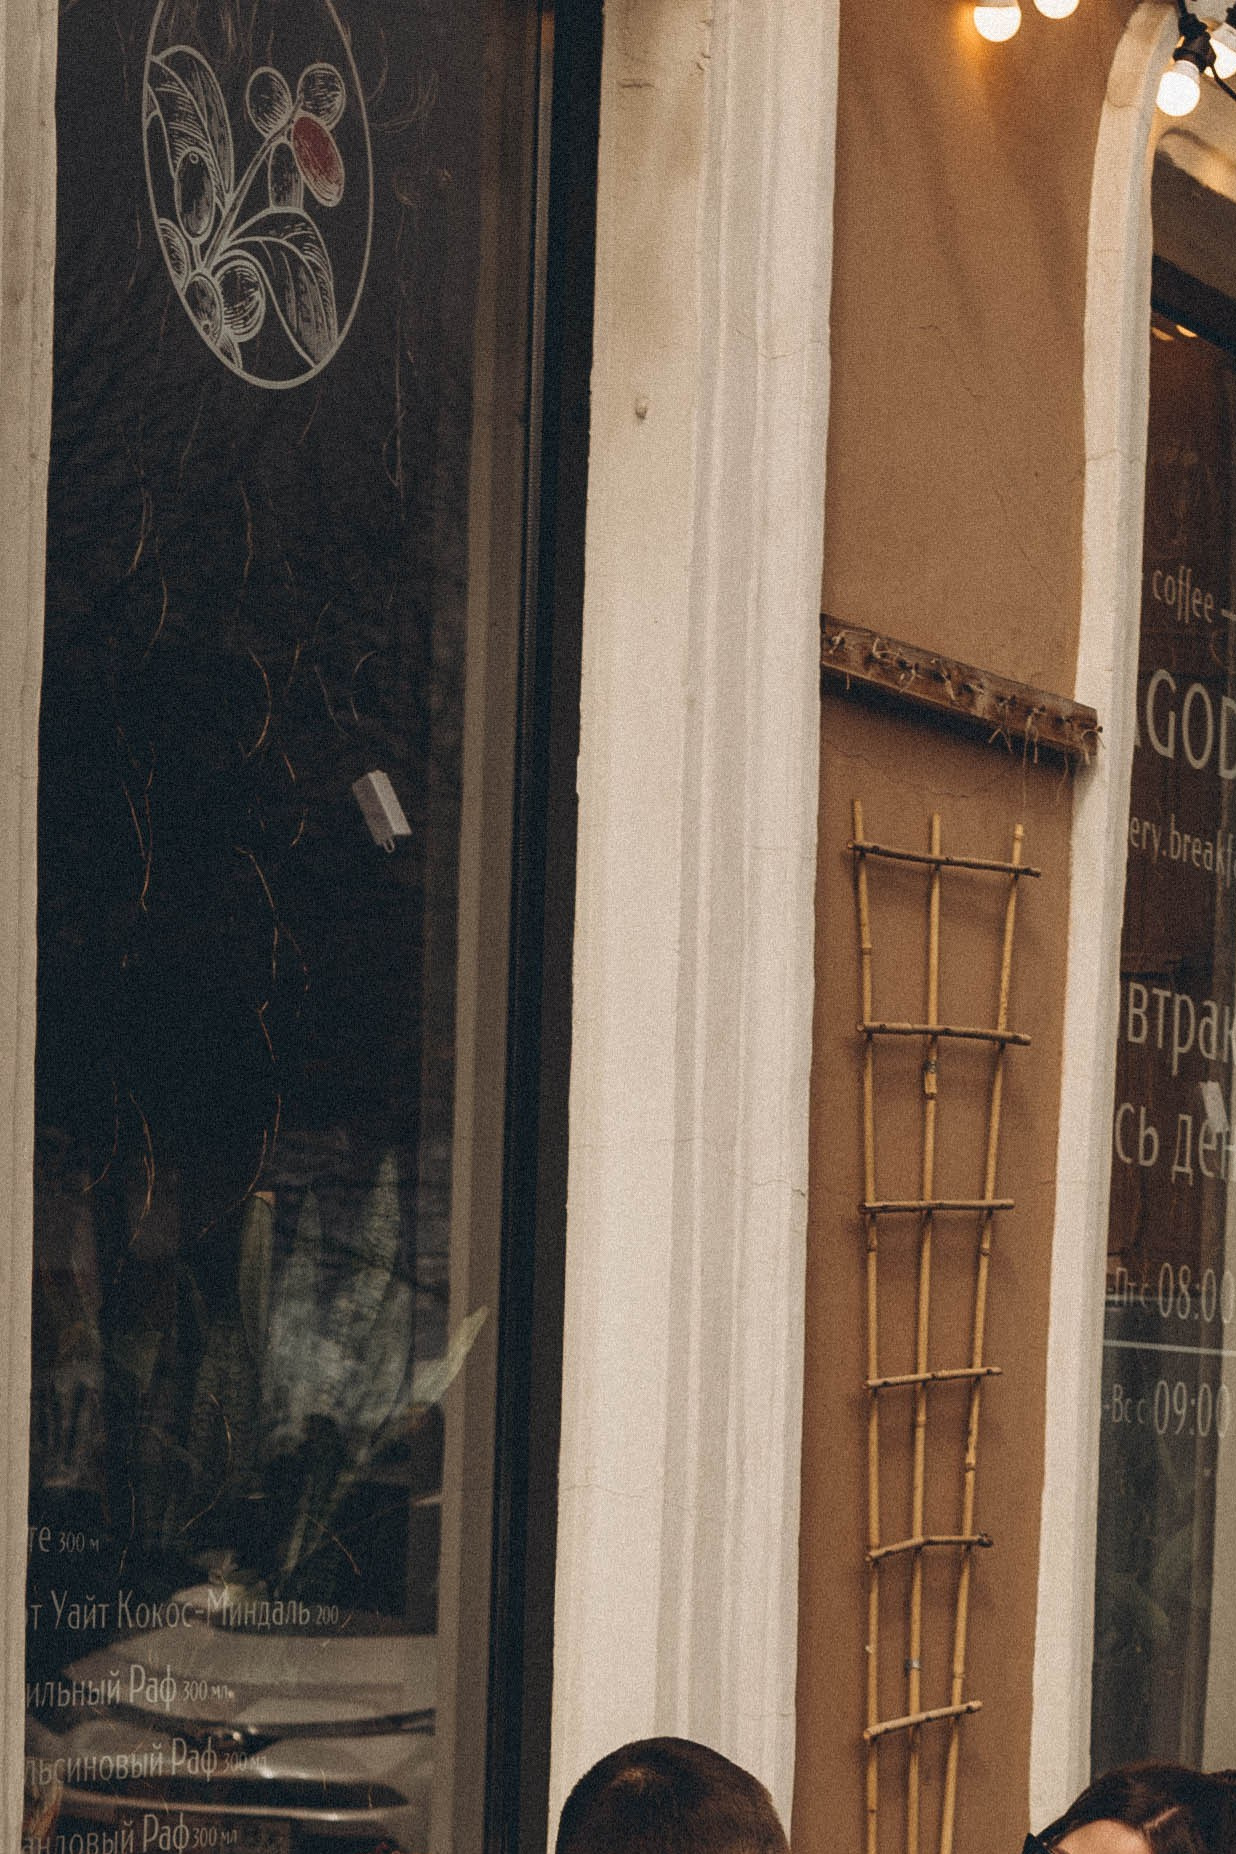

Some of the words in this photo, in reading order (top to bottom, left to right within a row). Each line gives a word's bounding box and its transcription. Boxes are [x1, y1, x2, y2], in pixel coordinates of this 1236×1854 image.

[1151, 565, 1215, 624] coffee
[1158, 1262, 1235, 1324] 08:00
[1154, 1380, 1231, 1438] 09:00
[59, 1532, 85, 1553] 300
[50, 1589, 110, 1631] Уайт
[315, 1604, 339, 1626] 200
[129, 1664, 177, 1710] Раф
[183, 1680, 208, 1701] 300
[171, 1737, 218, 1781] Раф
[224, 1752, 247, 1774] 300
[193, 1828, 217, 1847] 300
[220, 1830, 238, 1844] мл
